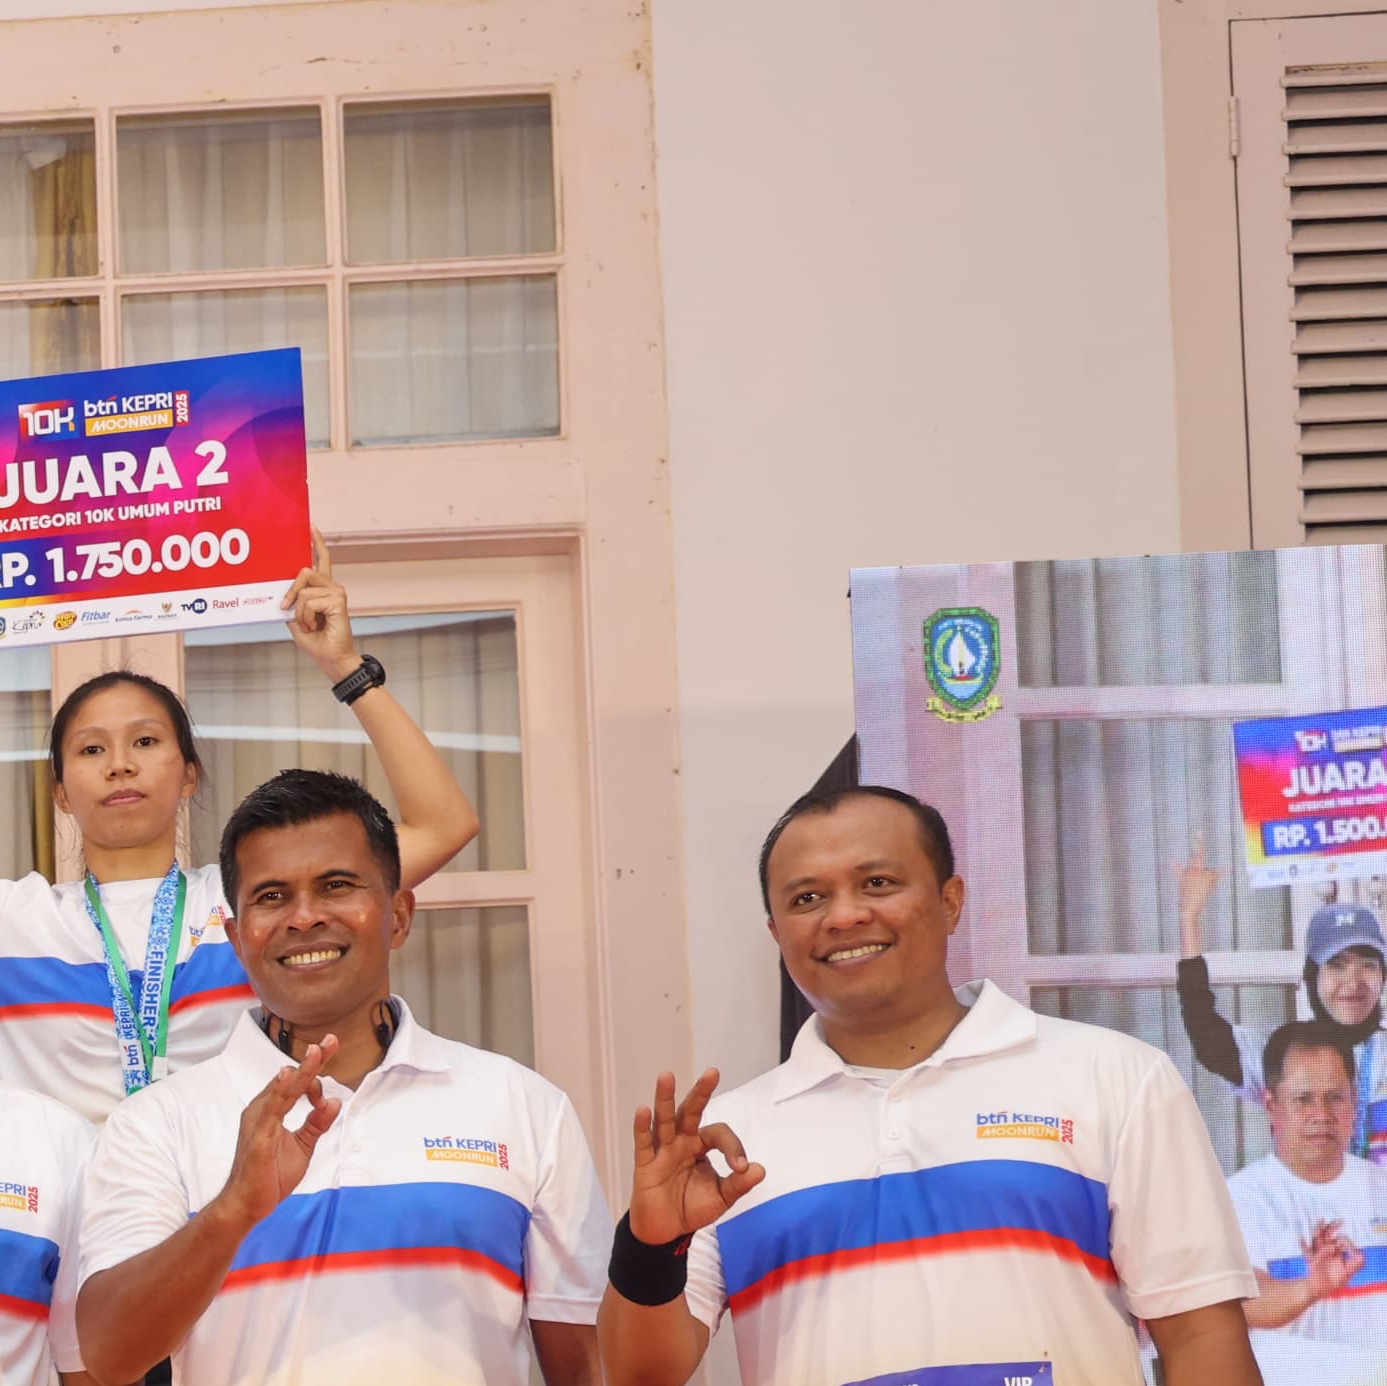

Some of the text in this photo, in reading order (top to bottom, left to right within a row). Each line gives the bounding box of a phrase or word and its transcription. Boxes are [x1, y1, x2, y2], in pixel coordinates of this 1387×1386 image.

[84, 392, 172, 415] btn KEPRI
[176, 394, 188, 422] 2025
[91, 413, 169, 433] MOONRUN
[195, 440, 228, 486] 2
[85, 508, 114, 524] 10K
[119, 503, 169, 520] UMUM
[174, 497, 221, 514] PUTRI
[45, 528, 250, 583] 1.750.000
[81, 611, 110, 622] Fitbar
[213, 598, 239, 609] Ravel
[1282, 759, 1387, 797] JUARA
[1273, 824, 1311, 848] RP.
[143, 951, 164, 1028] FINISHER
[119, 1007, 133, 1040] KEPRI
[123, 1044, 139, 1066] btn
[977, 1111, 1059, 1128] btn KEPRI
[982, 1127, 1055, 1136] MOONRUN
[424, 1136, 496, 1152] btn KEPRI
[499, 1144, 509, 1171] 2025
[28, 1187, 38, 1213] 2025
